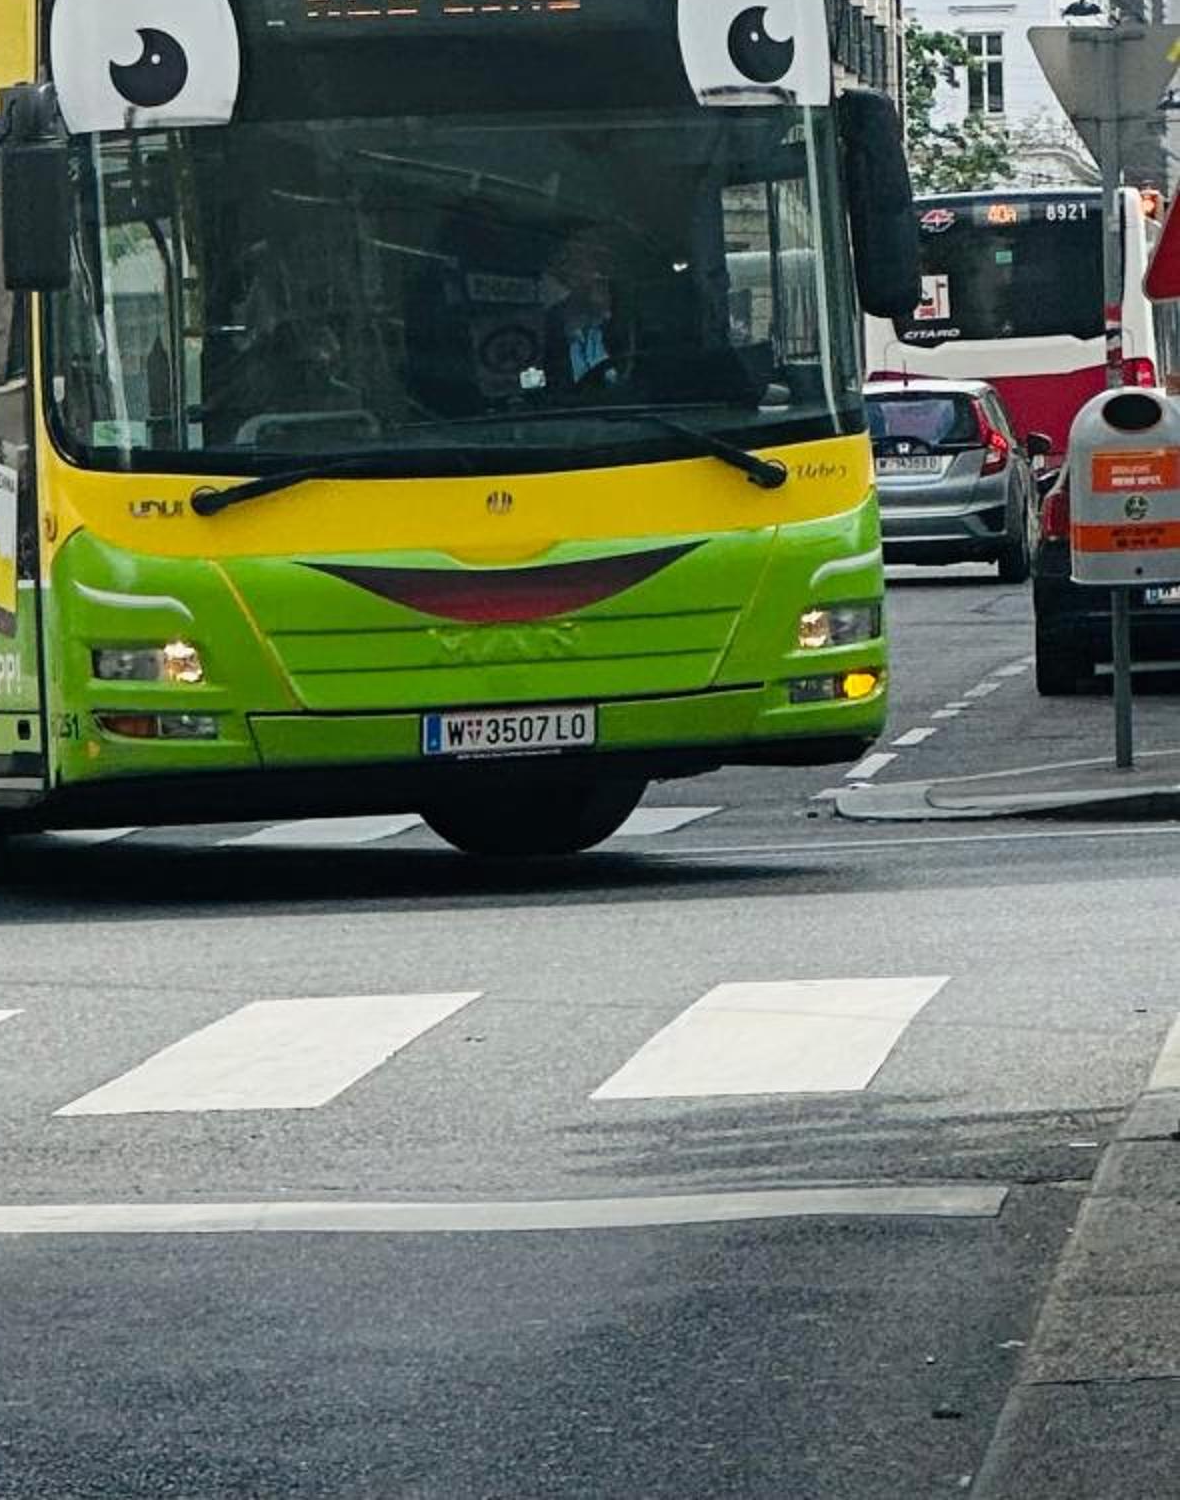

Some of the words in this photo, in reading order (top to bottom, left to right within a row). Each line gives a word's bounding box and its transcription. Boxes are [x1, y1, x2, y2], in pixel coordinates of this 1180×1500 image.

[1046, 203, 1087, 221] 8921
[903, 328, 960, 340] CITARO
[447, 721, 465, 746] W
